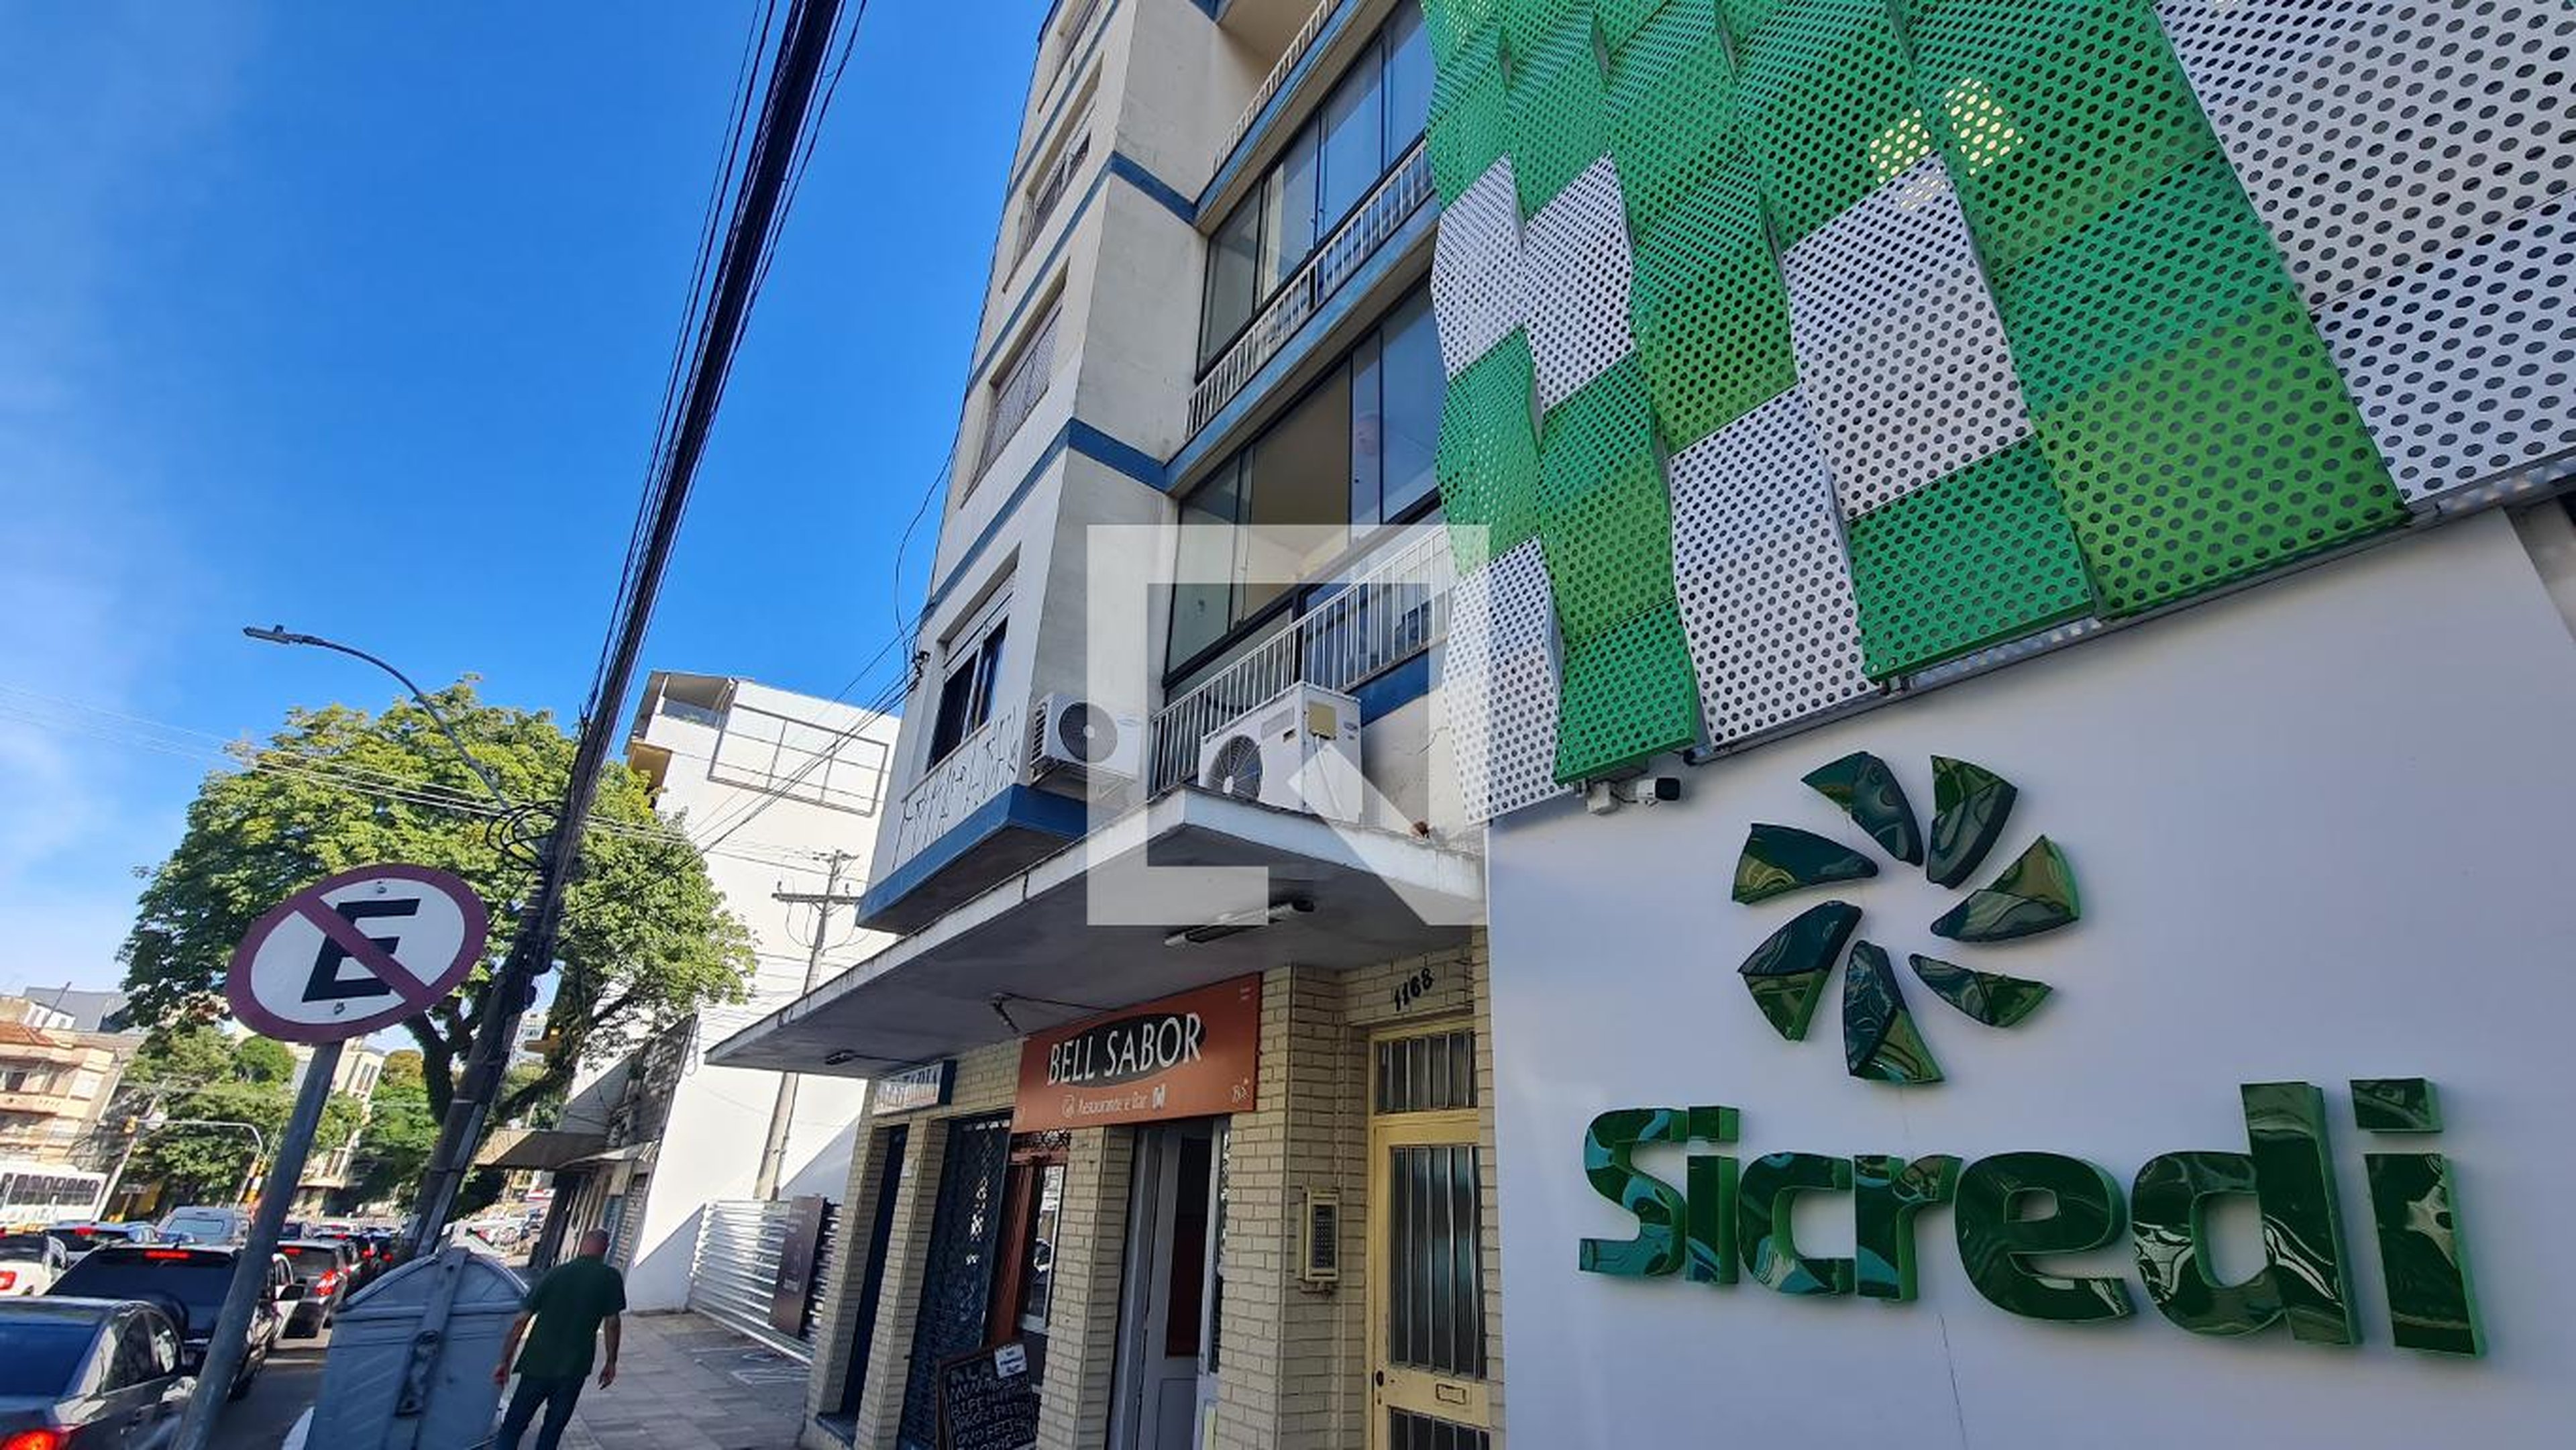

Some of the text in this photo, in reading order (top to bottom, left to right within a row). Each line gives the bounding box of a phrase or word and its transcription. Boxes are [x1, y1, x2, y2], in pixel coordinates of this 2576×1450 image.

[302, 898, 421, 1002] E
[1394, 968, 1434, 1013] 1168
[1046, 1012, 1202, 1086] BELL SABOR
[1578, 1078, 2488, 1357] Sicredi
